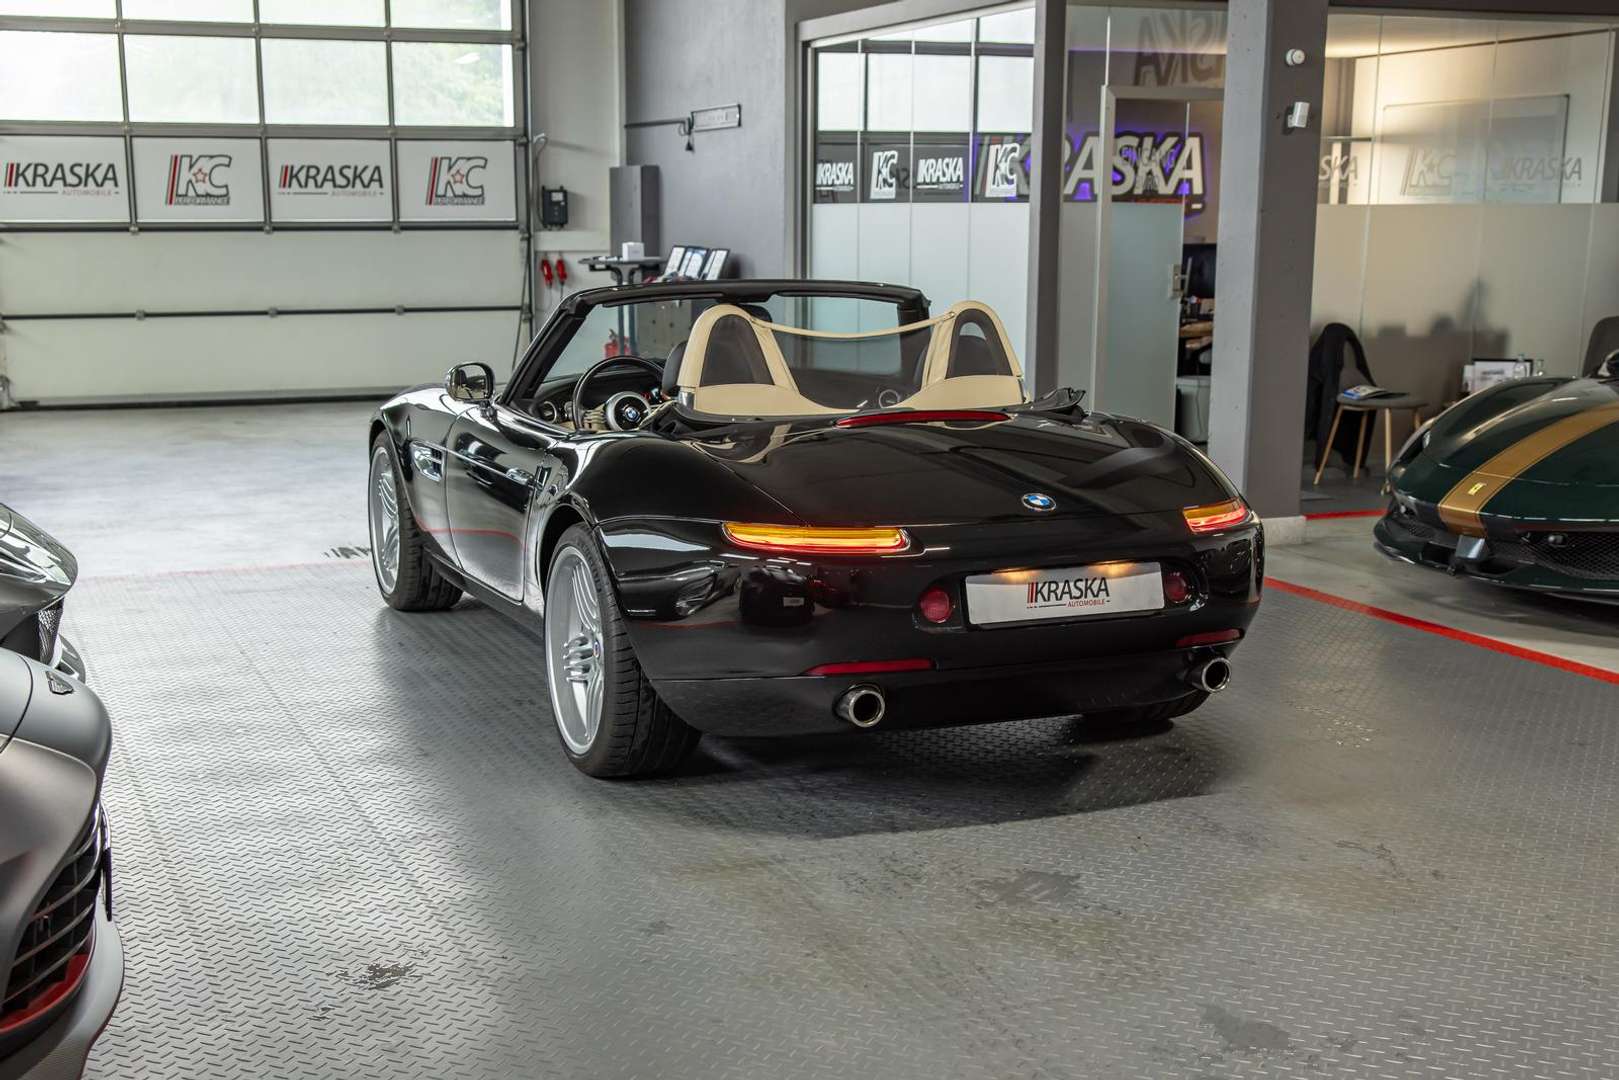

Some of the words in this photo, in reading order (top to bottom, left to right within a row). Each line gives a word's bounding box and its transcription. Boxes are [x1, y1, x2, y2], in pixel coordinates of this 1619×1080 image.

[14, 163, 119, 188] KRASKA
[176, 154, 232, 197] KC
[288, 165, 384, 189] KRASKA
[435, 156, 488, 198] KC
[818, 162, 854, 185] KRASKA
[919, 158, 964, 183] KRASKA
[1035, 577, 1110, 603] KRASKA
[1067, 598, 1105, 608] AUTOMOBILE
